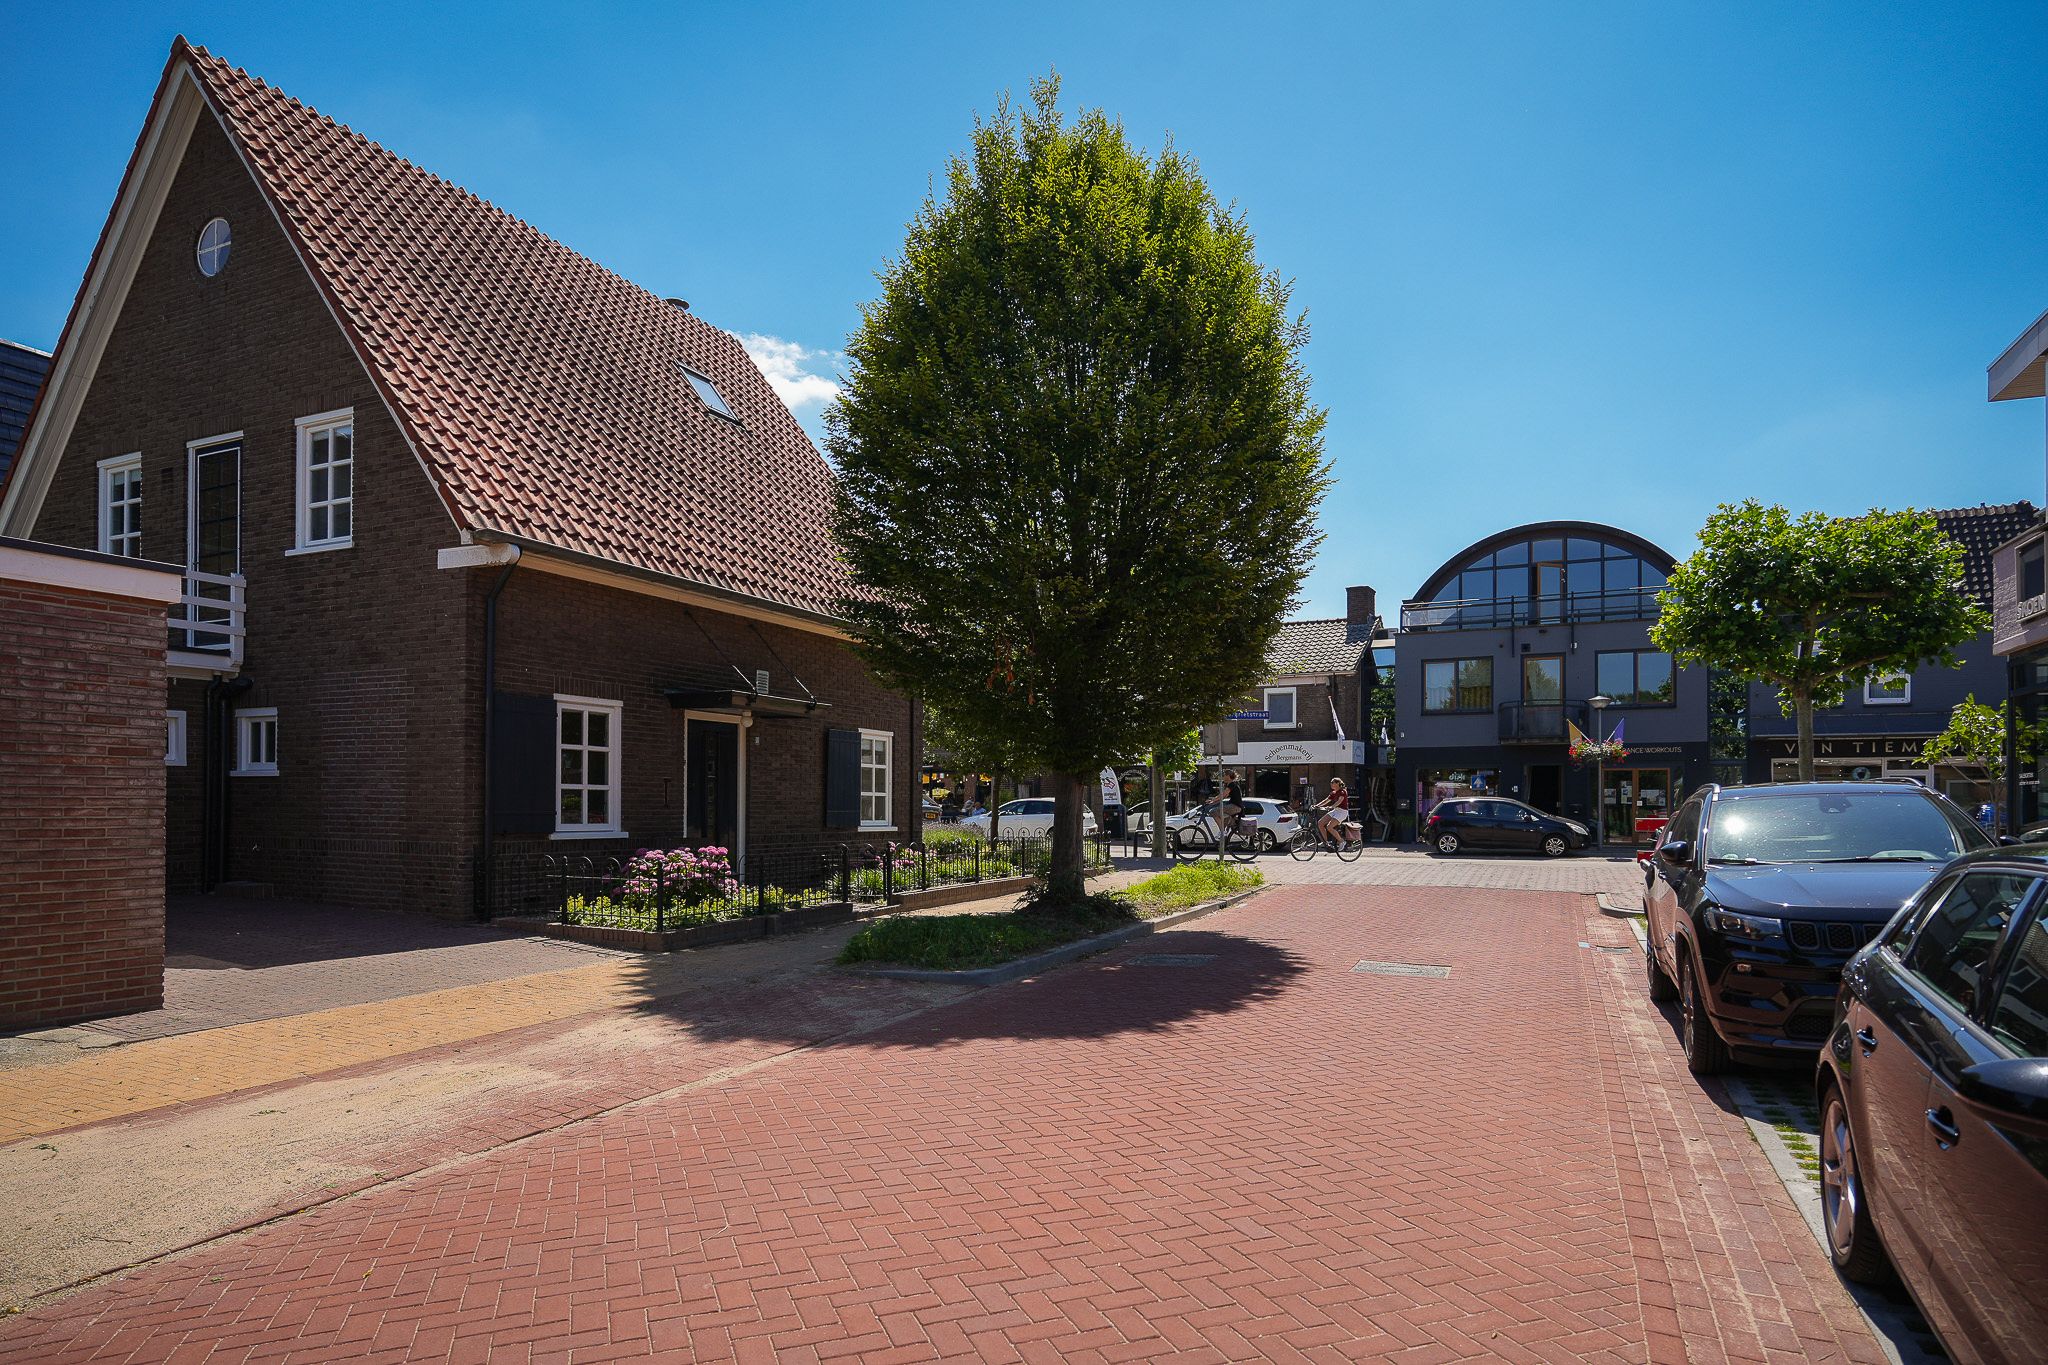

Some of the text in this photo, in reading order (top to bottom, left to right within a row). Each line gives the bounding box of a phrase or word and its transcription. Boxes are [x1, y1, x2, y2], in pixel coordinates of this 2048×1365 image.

[1264, 744, 1314, 762] Schoenmakerij
[1784, 741, 1918, 754] VN TIEM
[1276, 754, 1303, 762] Bergmans
